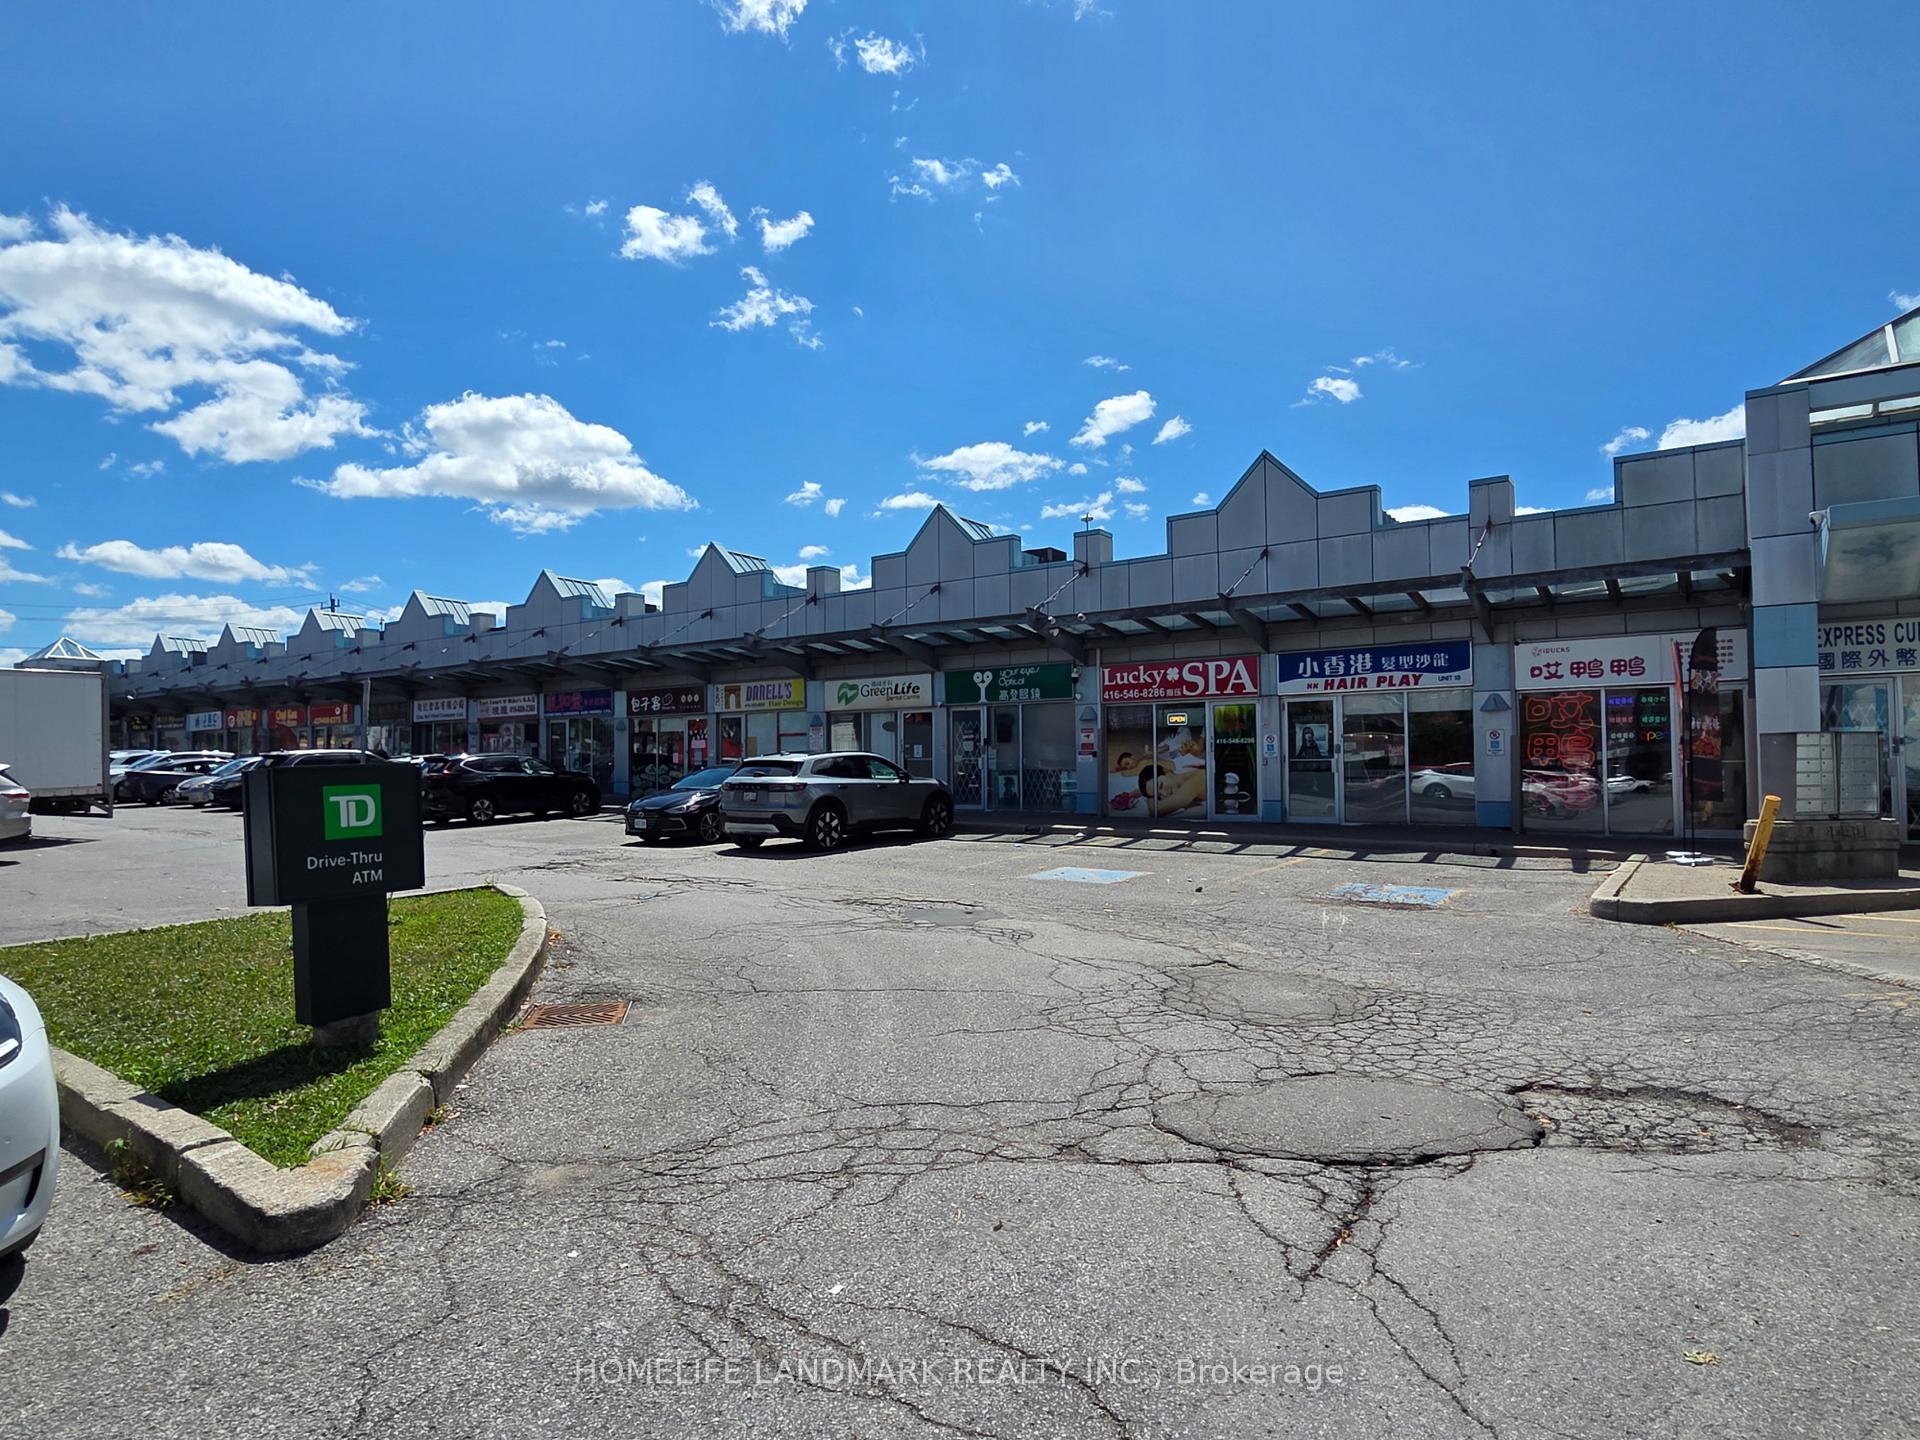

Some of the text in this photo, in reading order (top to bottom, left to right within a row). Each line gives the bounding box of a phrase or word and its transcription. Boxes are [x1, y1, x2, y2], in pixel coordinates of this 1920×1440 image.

[1894, 622, 1920, 643] CU
[1299, 653, 1373, 678] 小香港
[1103, 659, 1259, 696] Lucky SPA
[1324, 677, 1368, 691] HAIR
[1376, 673, 1423, 688] PLAY
[1103, 688, 1165, 699] 416-546-8286
[329, 795, 376, 828] TD
[307, 851, 382, 870] Drive-Thru
[352, 869, 382, 885] ATM
